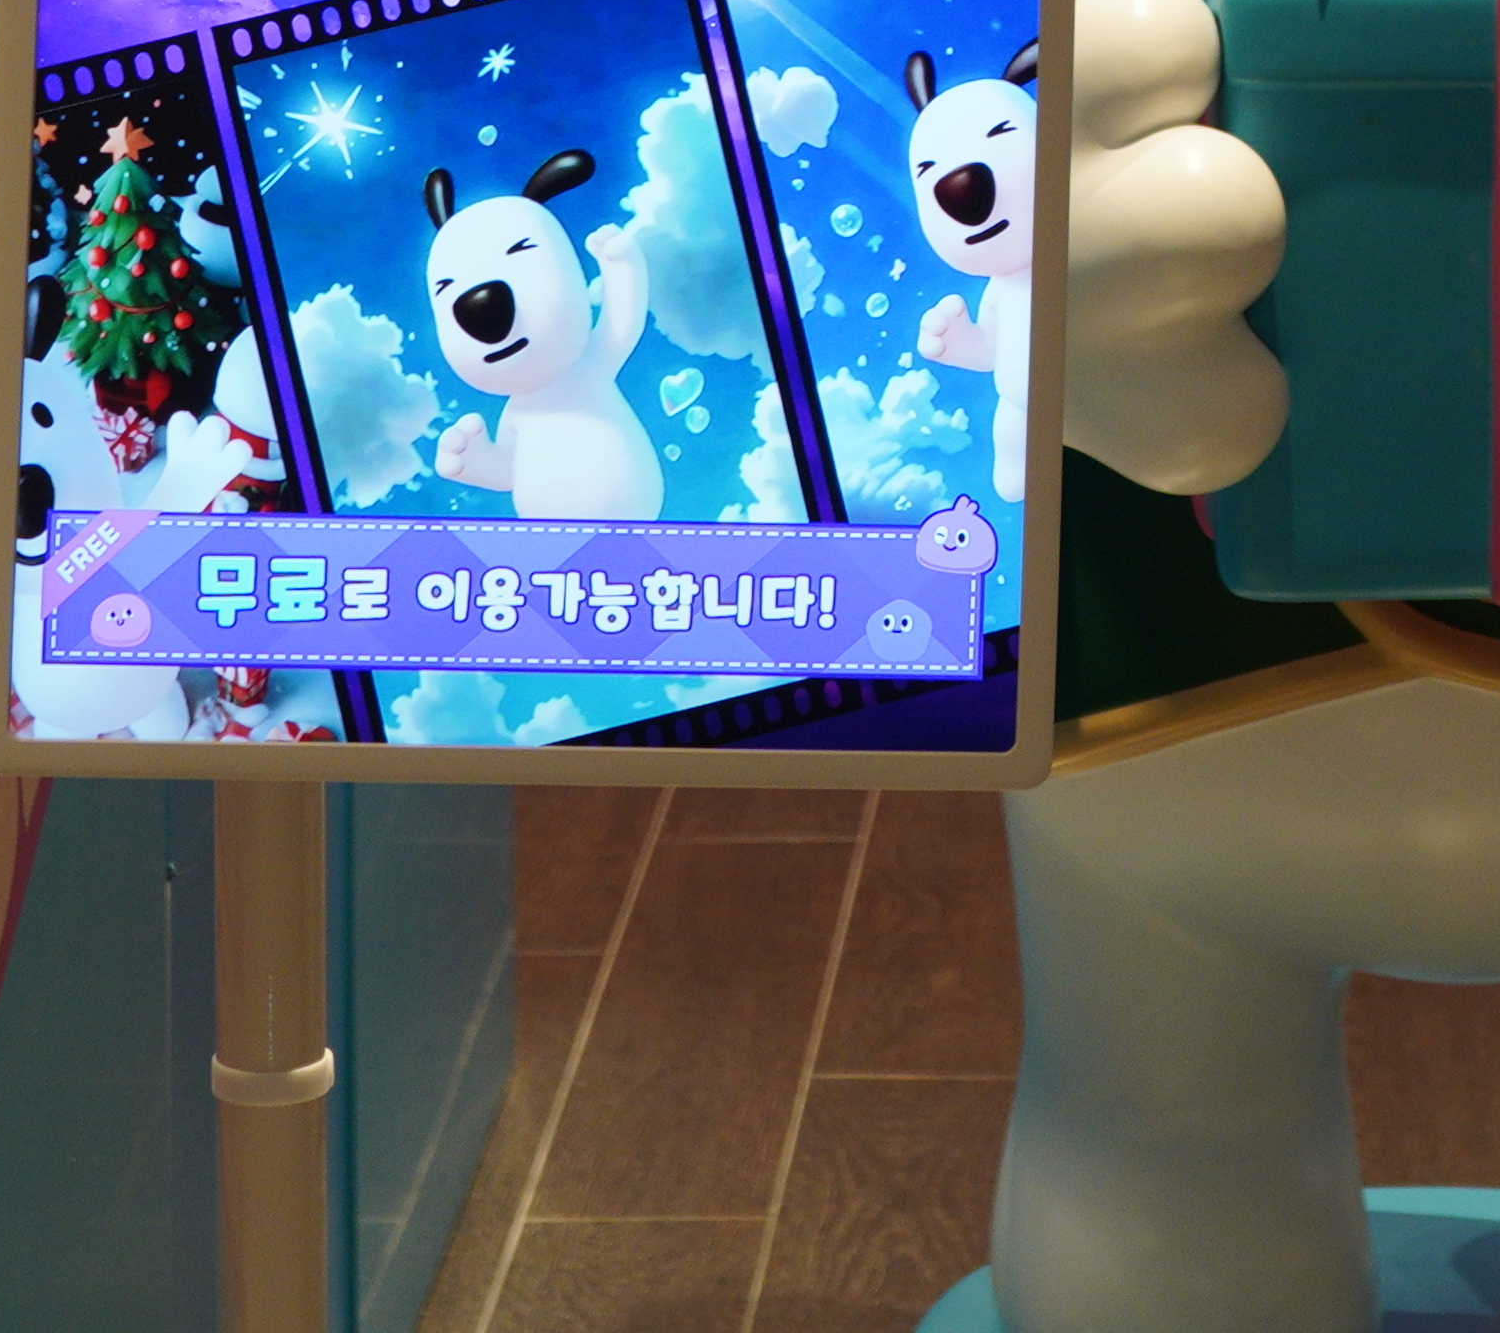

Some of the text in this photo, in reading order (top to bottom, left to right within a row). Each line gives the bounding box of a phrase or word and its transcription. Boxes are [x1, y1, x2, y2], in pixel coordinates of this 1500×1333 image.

[56, 519, 122, 585] FREE
[197, 553, 838, 634] 무료로 이용가능합니다!
